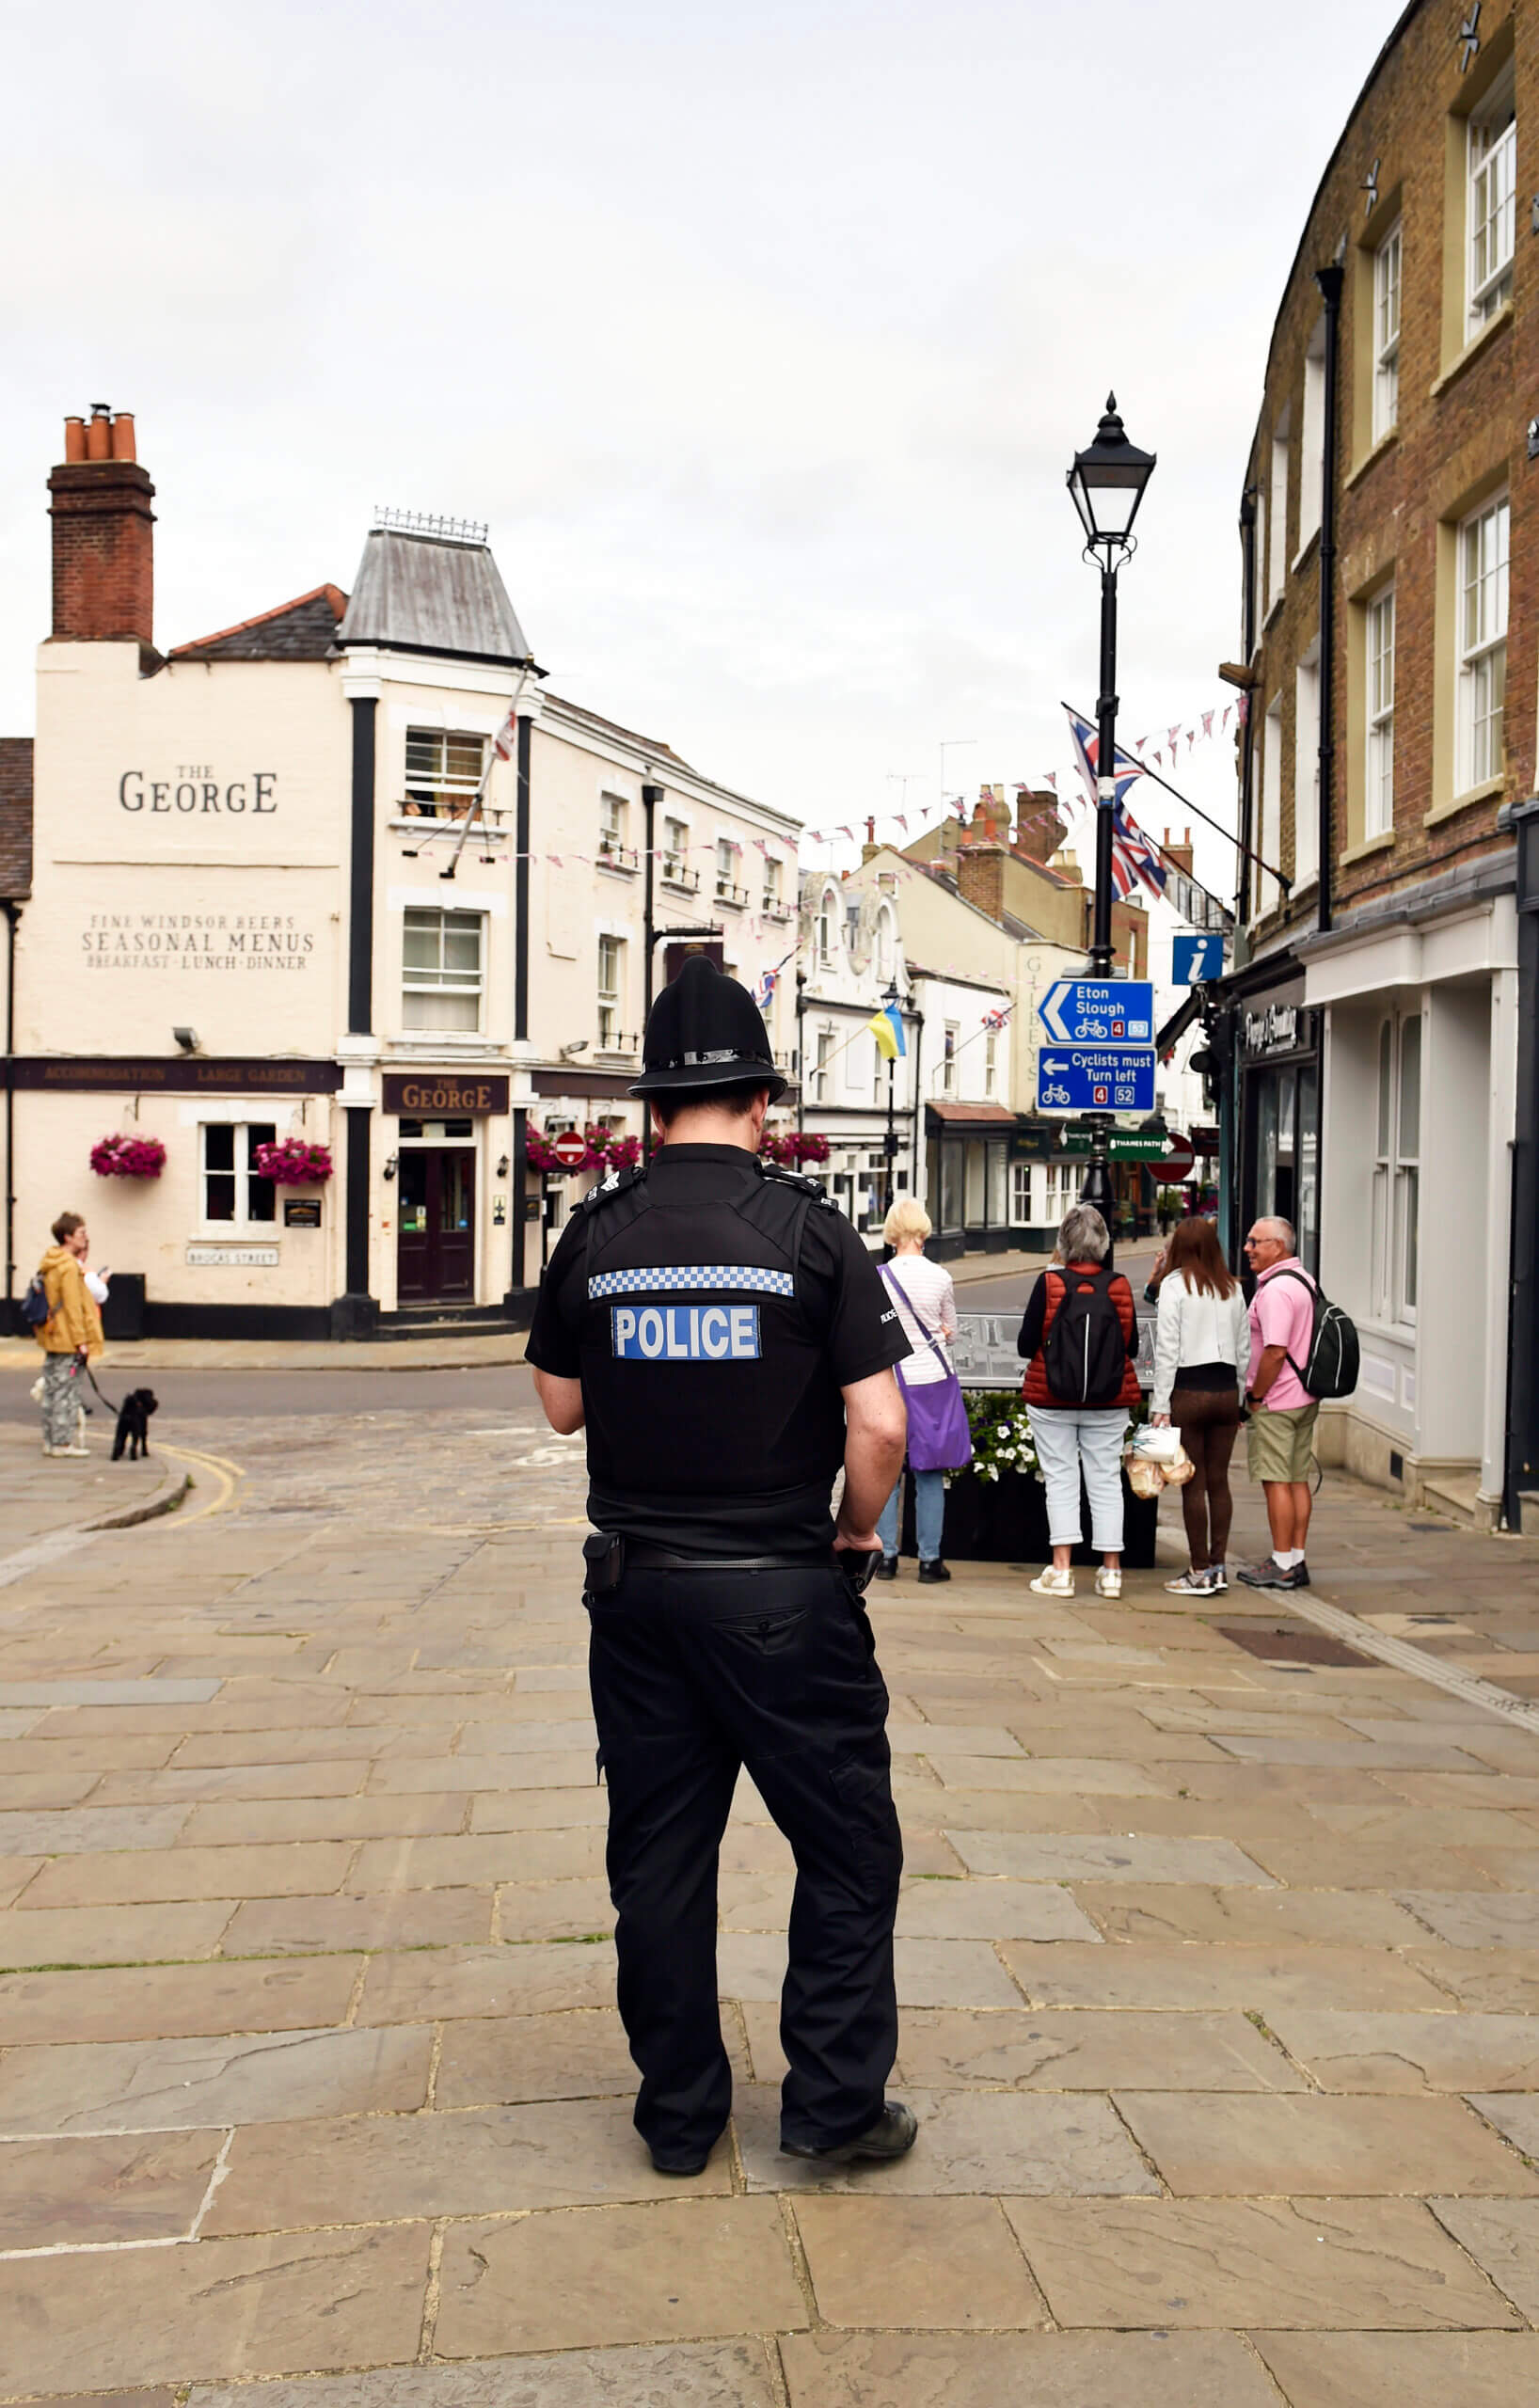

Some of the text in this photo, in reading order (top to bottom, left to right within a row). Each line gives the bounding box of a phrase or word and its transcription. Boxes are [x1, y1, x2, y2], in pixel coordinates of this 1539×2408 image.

[177, 766, 214, 779] THE
[119, 770, 278, 813] GEORGE
[91, 915, 295, 929] FINE WINDSOR BEERS
[83, 932, 314, 952] SEASONAL MENUS
[87, 955, 307, 970] BREAKFAST LUNCH DINNER
[1076, 986, 1109, 999] Eton
[1076, 1002, 1125, 1017] Slough
[1114, 1023, 1122, 1033] 4
[1072, 1053, 1151, 1068] Cyclists must
[1086, 1069, 1136, 1083] Turn left
[402, 1085, 491, 1108] GEORGE
[1096, 1089, 1133, 1101] 4 52
[616, 1308, 755, 1358] POLICE
